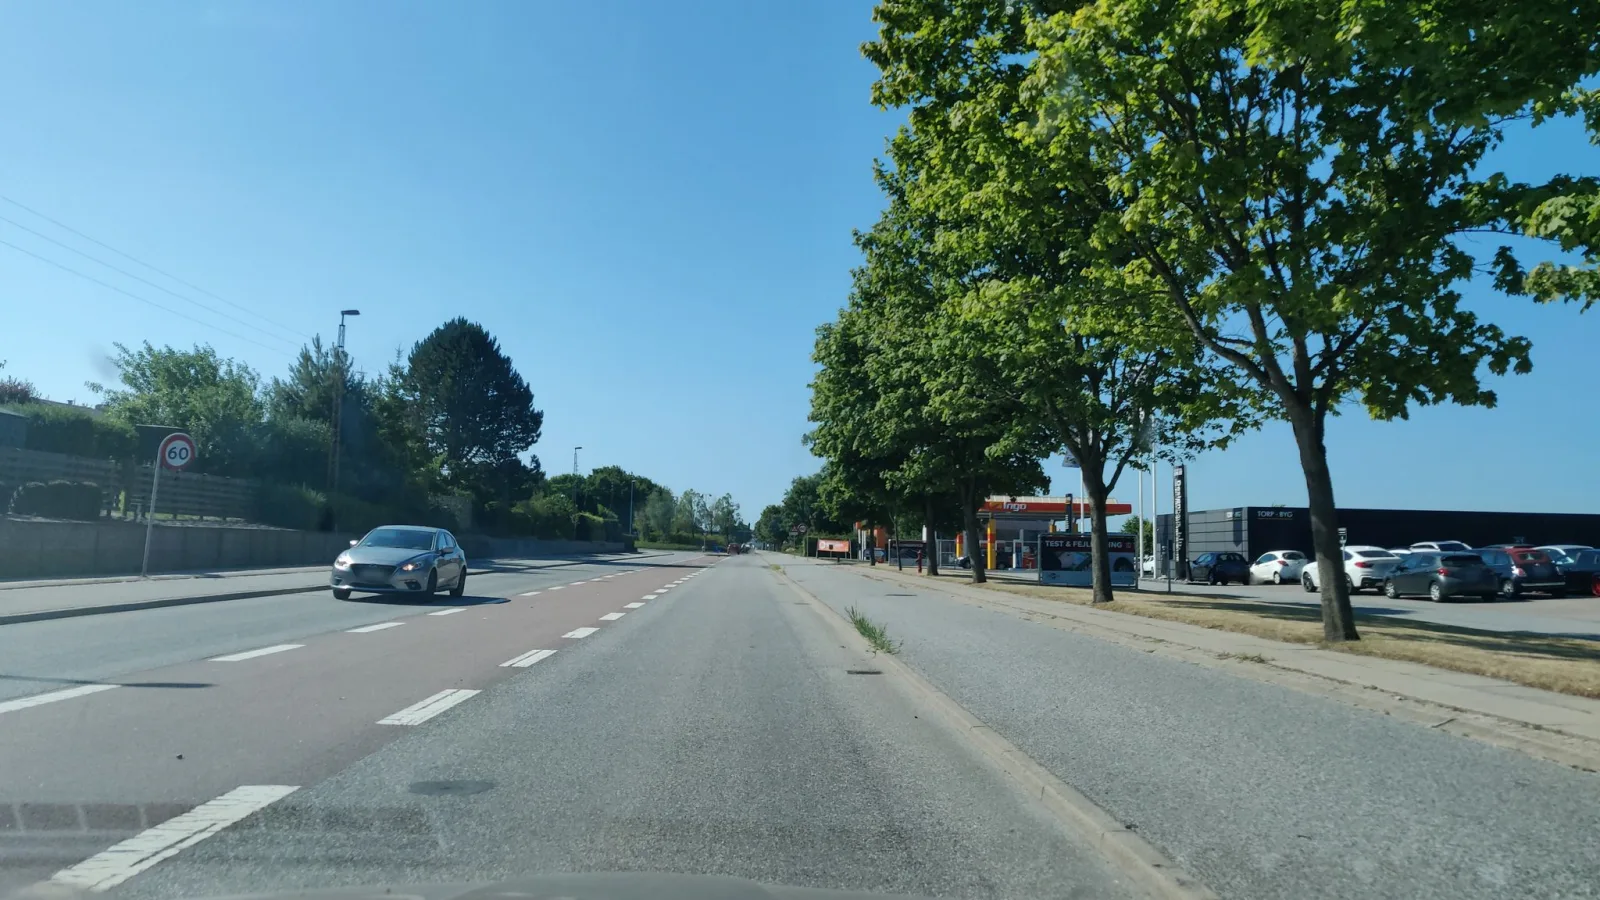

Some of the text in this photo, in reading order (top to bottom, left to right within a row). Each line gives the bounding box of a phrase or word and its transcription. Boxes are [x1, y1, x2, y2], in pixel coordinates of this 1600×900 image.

[168, 447, 188, 460] 60
[1003, 501, 1027, 511] Ingo
[1072, 540, 1123, 548] FEJLING
